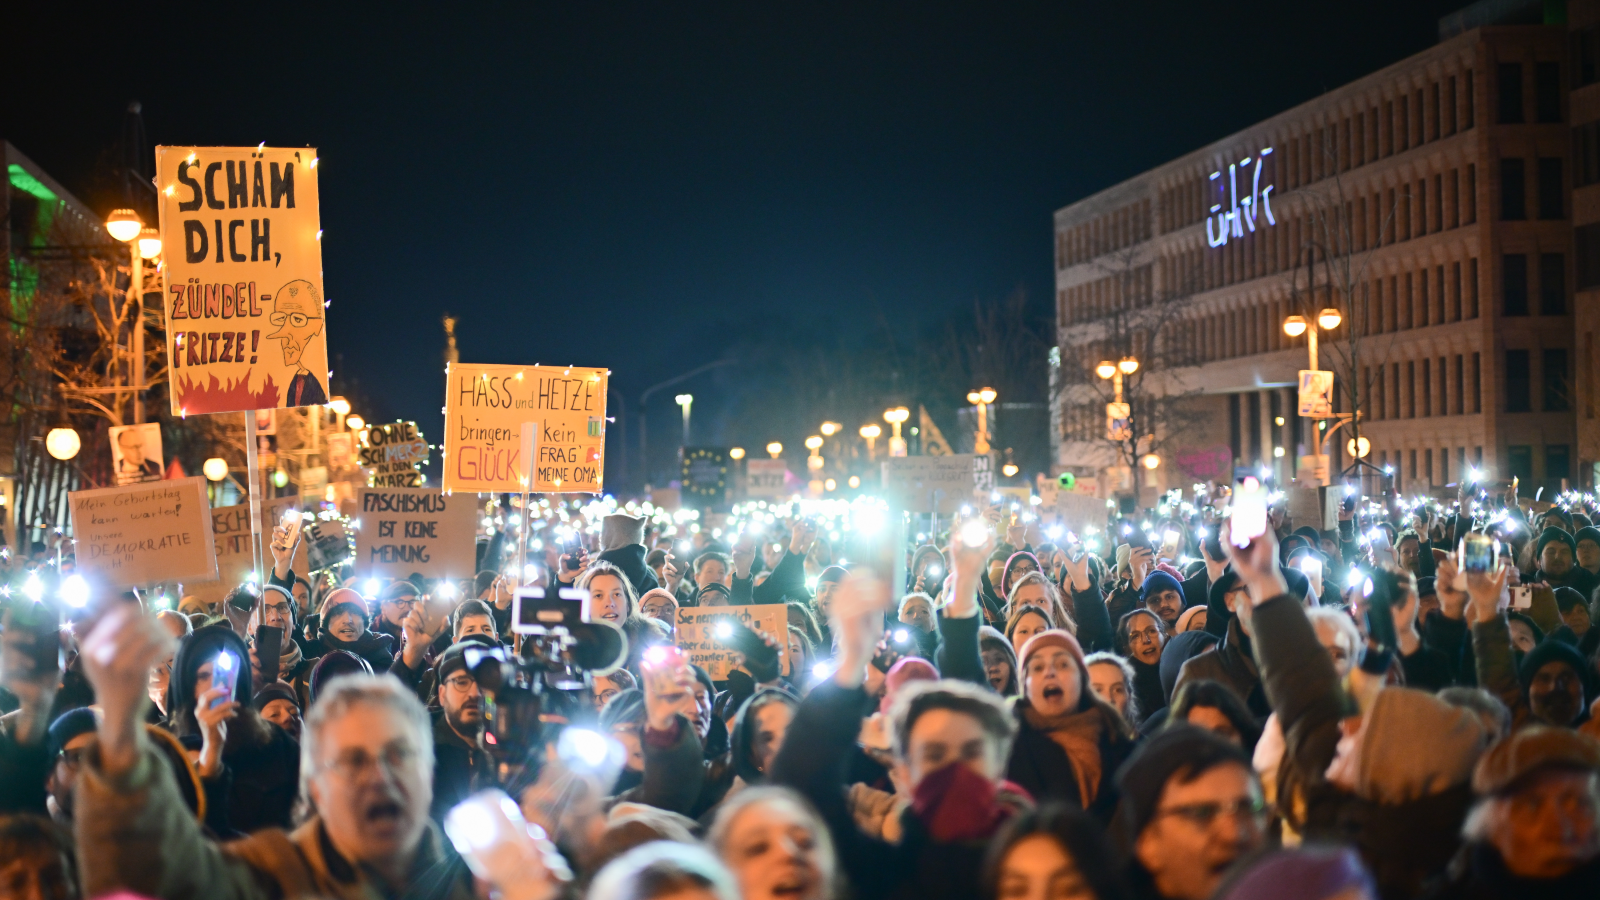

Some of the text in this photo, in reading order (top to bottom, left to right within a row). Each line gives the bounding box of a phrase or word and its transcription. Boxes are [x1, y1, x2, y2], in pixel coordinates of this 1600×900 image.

[177, 151, 301, 212] SCHÄM'
[184, 218, 282, 268] DICH,
[170, 278, 272, 319] ZÜNDEL-
[173, 330, 261, 368] FRITZE!
[460, 375, 596, 411] HASS und HETZE
[369, 424, 416, 446] OHNE
[460, 415, 576, 446] bringen kein
[360, 442, 427, 466] SCHMERZ
[458, 446, 520, 481] GLÜCK
[540, 445, 582, 463] FRAG'
[379, 461, 411, 473] IN DEN
[538, 467, 598, 484] MEINE OMA
[374, 472, 420, 488] MÄRZ
[76, 489, 181, 511] Mein Geburtstag
[364, 493, 446, 513] FASCHISMUS
[91, 503, 182, 525] kann warten!
[378, 520, 438, 538] IST KEINE
[89, 532, 192, 560] DEMOKRATIE
[371, 545, 430, 563] MEINUNG
[677, 608, 694, 624] Sie
[678, 640, 699, 650] aber
[700, 641, 711, 650] du
